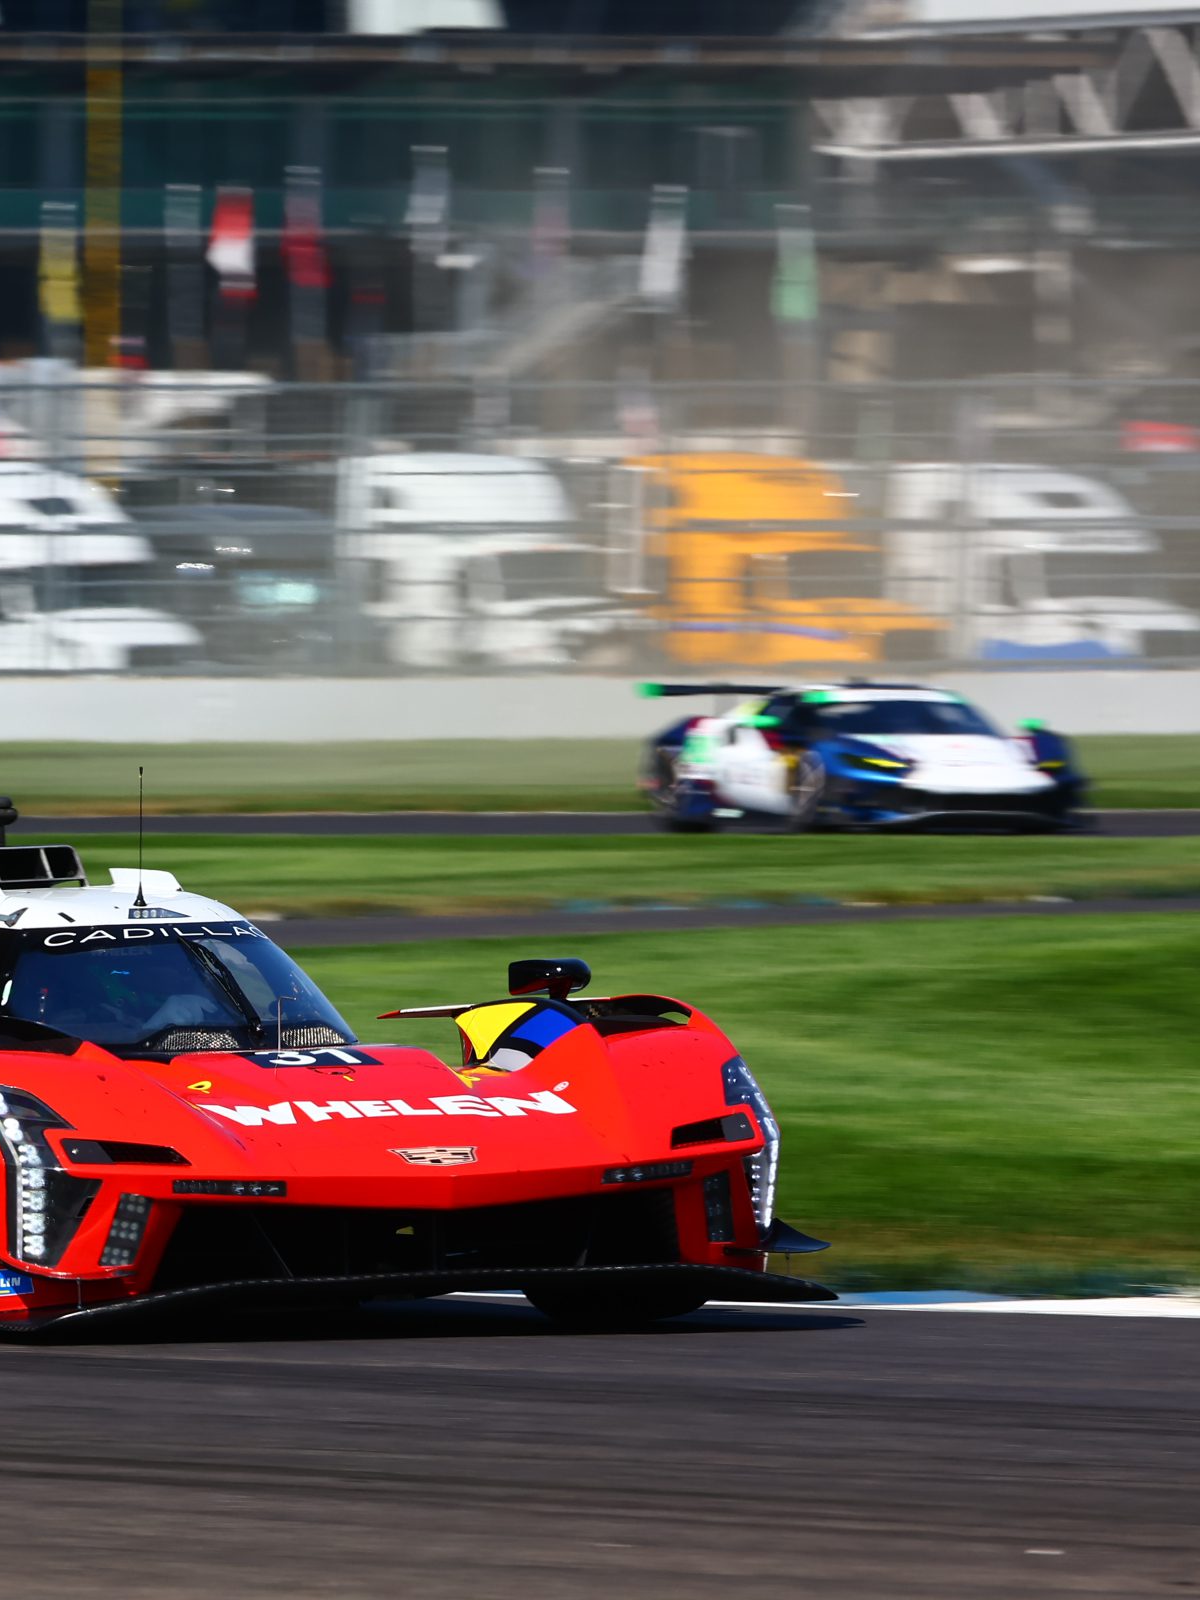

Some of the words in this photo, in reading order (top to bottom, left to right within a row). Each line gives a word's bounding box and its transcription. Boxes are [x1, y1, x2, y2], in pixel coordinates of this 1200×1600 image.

[44, 926, 268, 947] CADILLAC
[255, 1049, 363, 1066] 31
[196, 1090, 578, 1126] WHELEN
